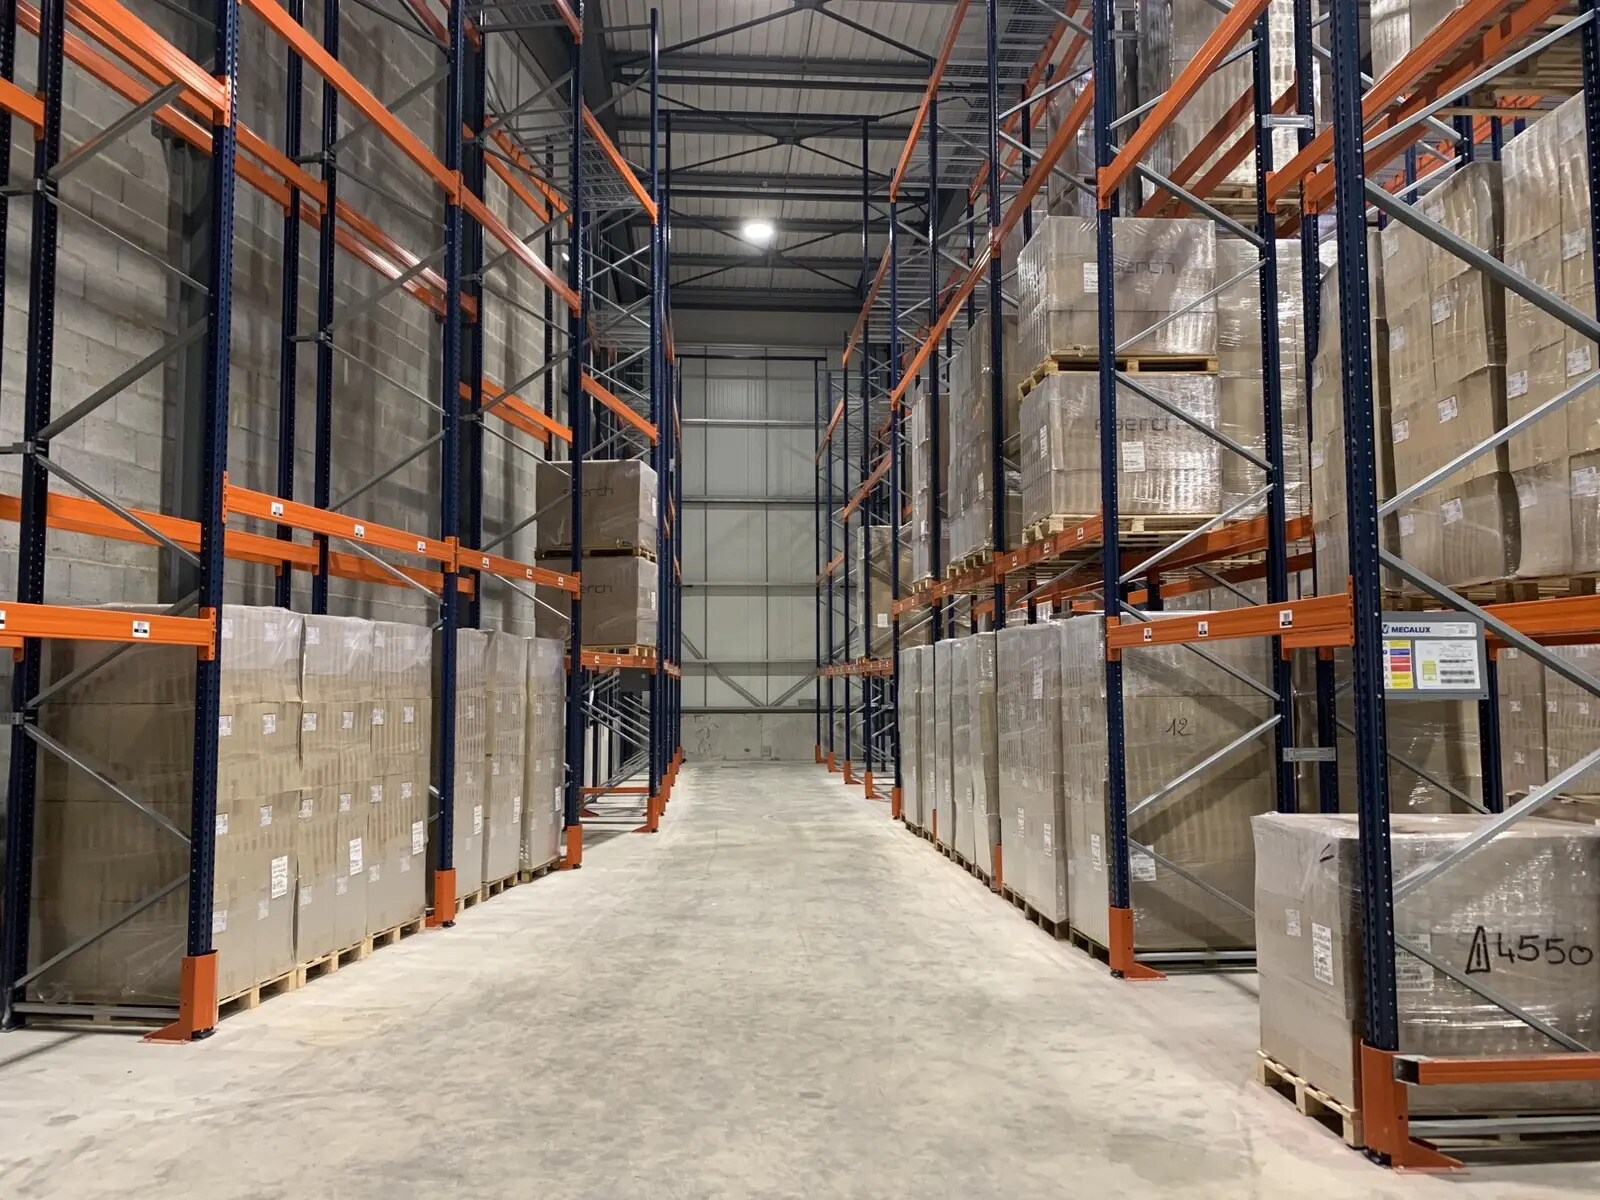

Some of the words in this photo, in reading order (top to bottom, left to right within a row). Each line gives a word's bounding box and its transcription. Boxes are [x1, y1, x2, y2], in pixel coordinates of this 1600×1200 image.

[1391, 626, 1431, 634] MECALUX
[1165, 717, 1193, 736] 12
[1497, 932, 1594, 966] 4550
